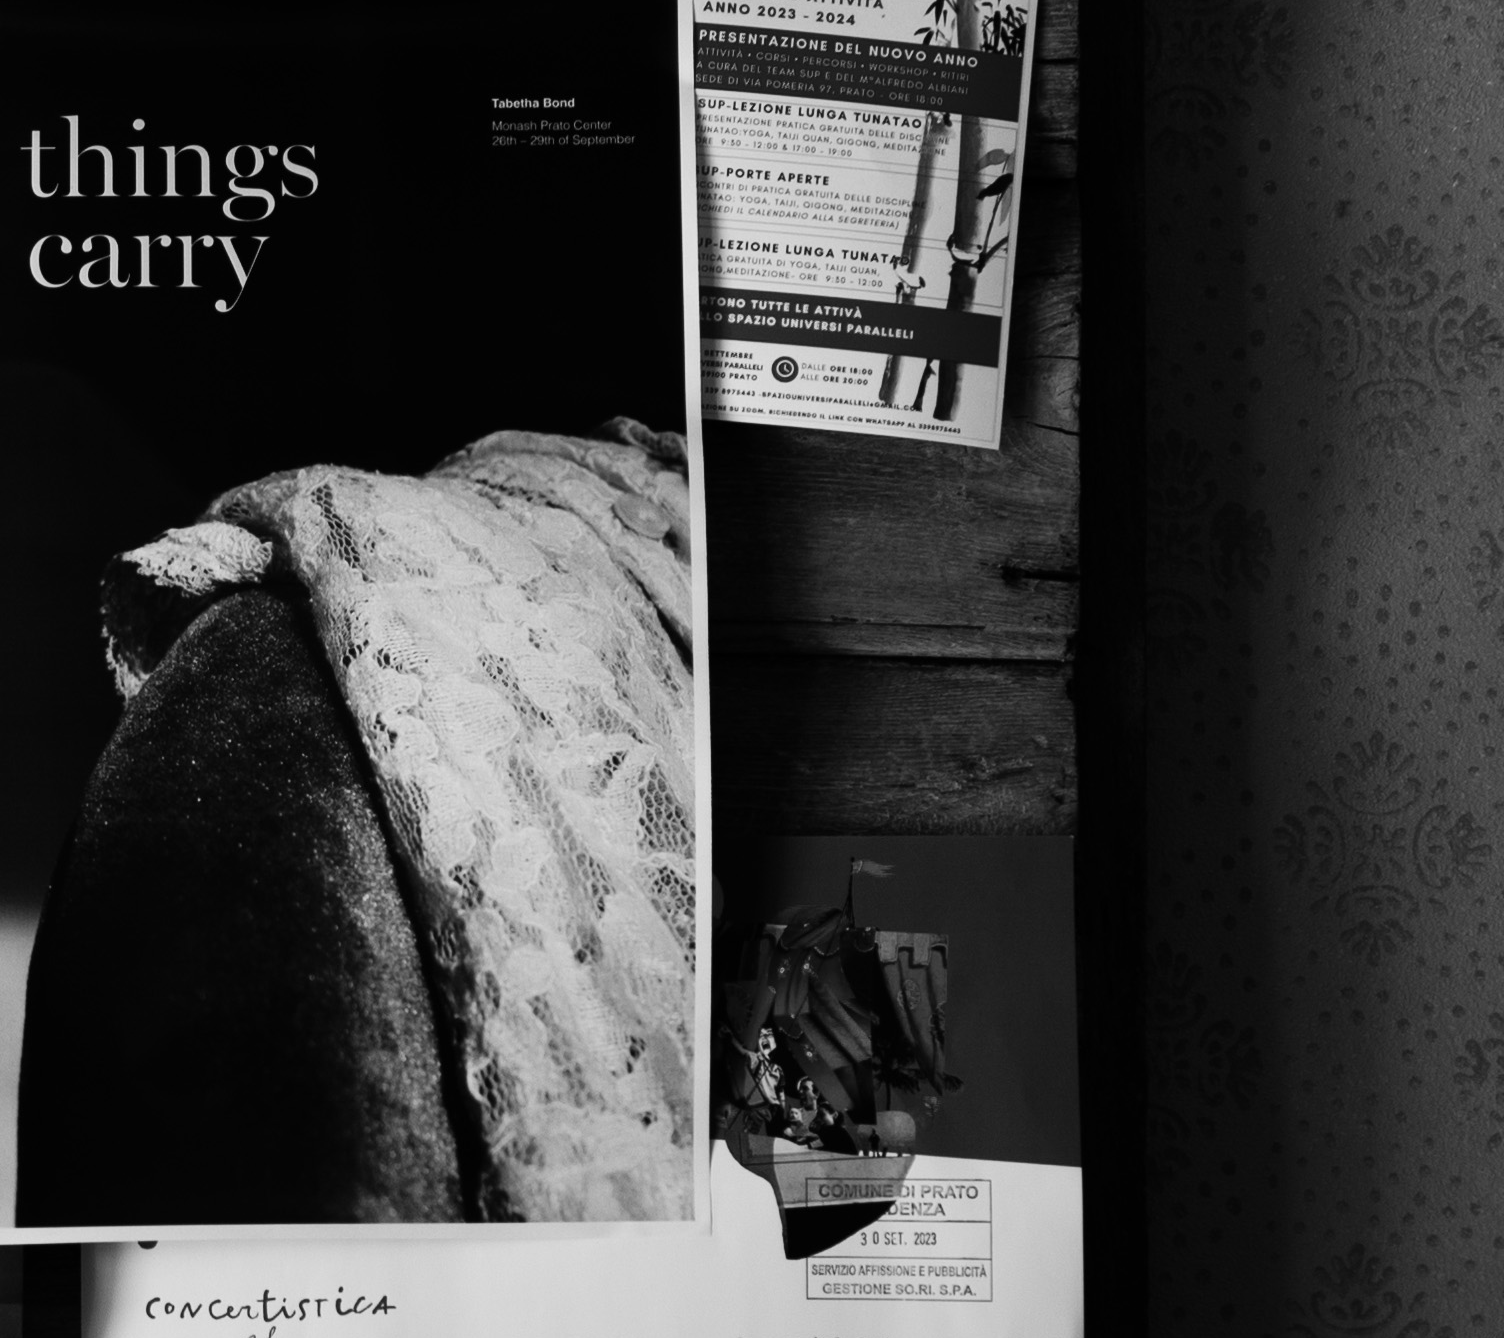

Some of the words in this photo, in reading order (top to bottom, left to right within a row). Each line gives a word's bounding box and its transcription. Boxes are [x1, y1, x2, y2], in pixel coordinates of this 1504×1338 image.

[703, 0, 751, 15] ANNO
[757, 5, 796, 20] 2023
[815, 10, 856, 26] 2024
[699, 29, 828, 52] PRESENTAZIONE
[834, 41, 862, 55] DEL
[868, 45, 927, 62] NUOVO
[933, 52, 978, 68] ANNO
[491, 98, 540, 109] Tabetha
[543, 97, 575, 108] Bond
[491, 120, 537, 131] Monash
[540, 119, 571, 131] Prato
[573, 119, 612, 131] Center
[492, 135, 517, 146] 26th
[530, 135, 555, 146] 29th
[558, 134, 569, 145] of
[572, 134, 635, 147] September
[20, 114, 319, 222] things
[29, 234, 269, 313] carry
